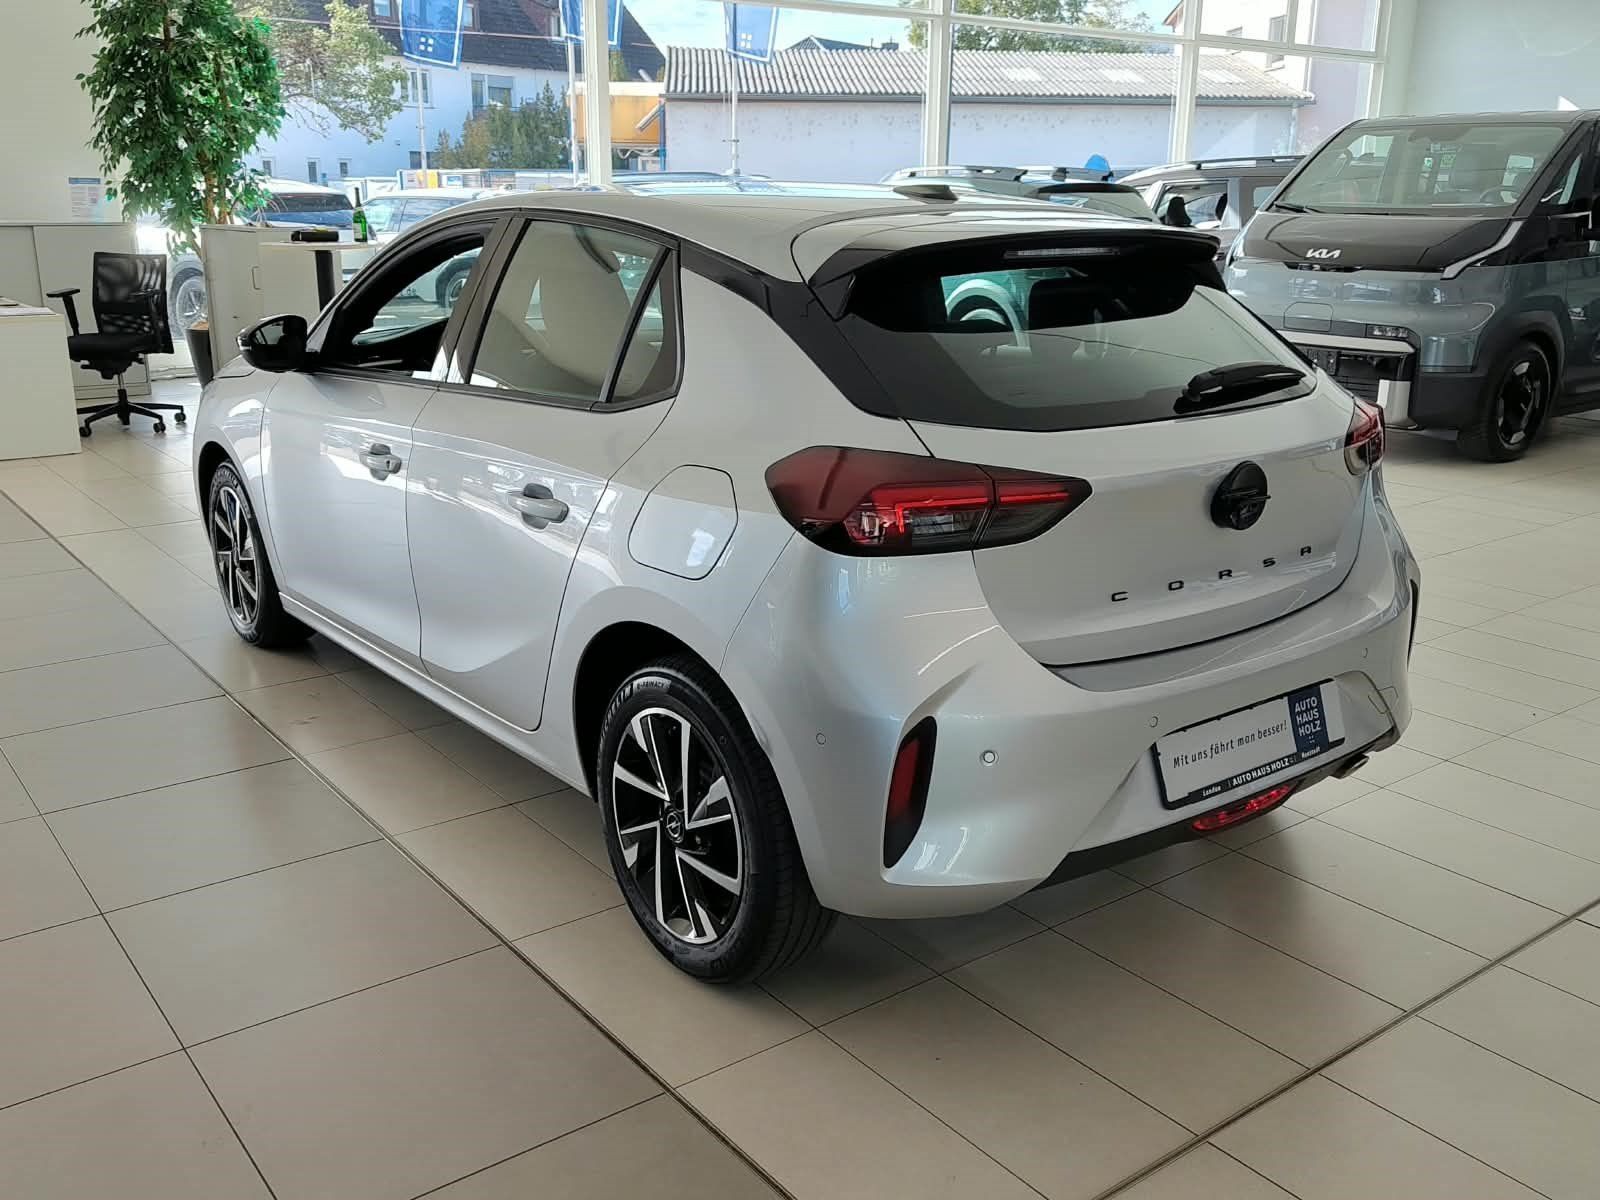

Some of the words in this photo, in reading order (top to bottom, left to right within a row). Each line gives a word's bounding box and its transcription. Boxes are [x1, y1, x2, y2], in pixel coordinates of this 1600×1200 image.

[1305, 248, 1341, 259] KIA
[1111, 546, 1312, 602] CORSA
[1295, 696, 1318, 713] AUTO
[1296, 708, 1319, 726] HAUS
[1299, 720, 1321, 737] HOLZ
[1173, 755, 1189, 769] Mit
[1191, 750, 1208, 763] uns
[1210, 739, 1235, 759] fährt
[1237, 733, 1256, 747] man
[1257, 720, 1287, 740] besser!
[1232, 773, 1251, 786] AUTO
[1251, 766, 1271, 780] HAUS
[1271, 758, 1289, 771] HOLZ
